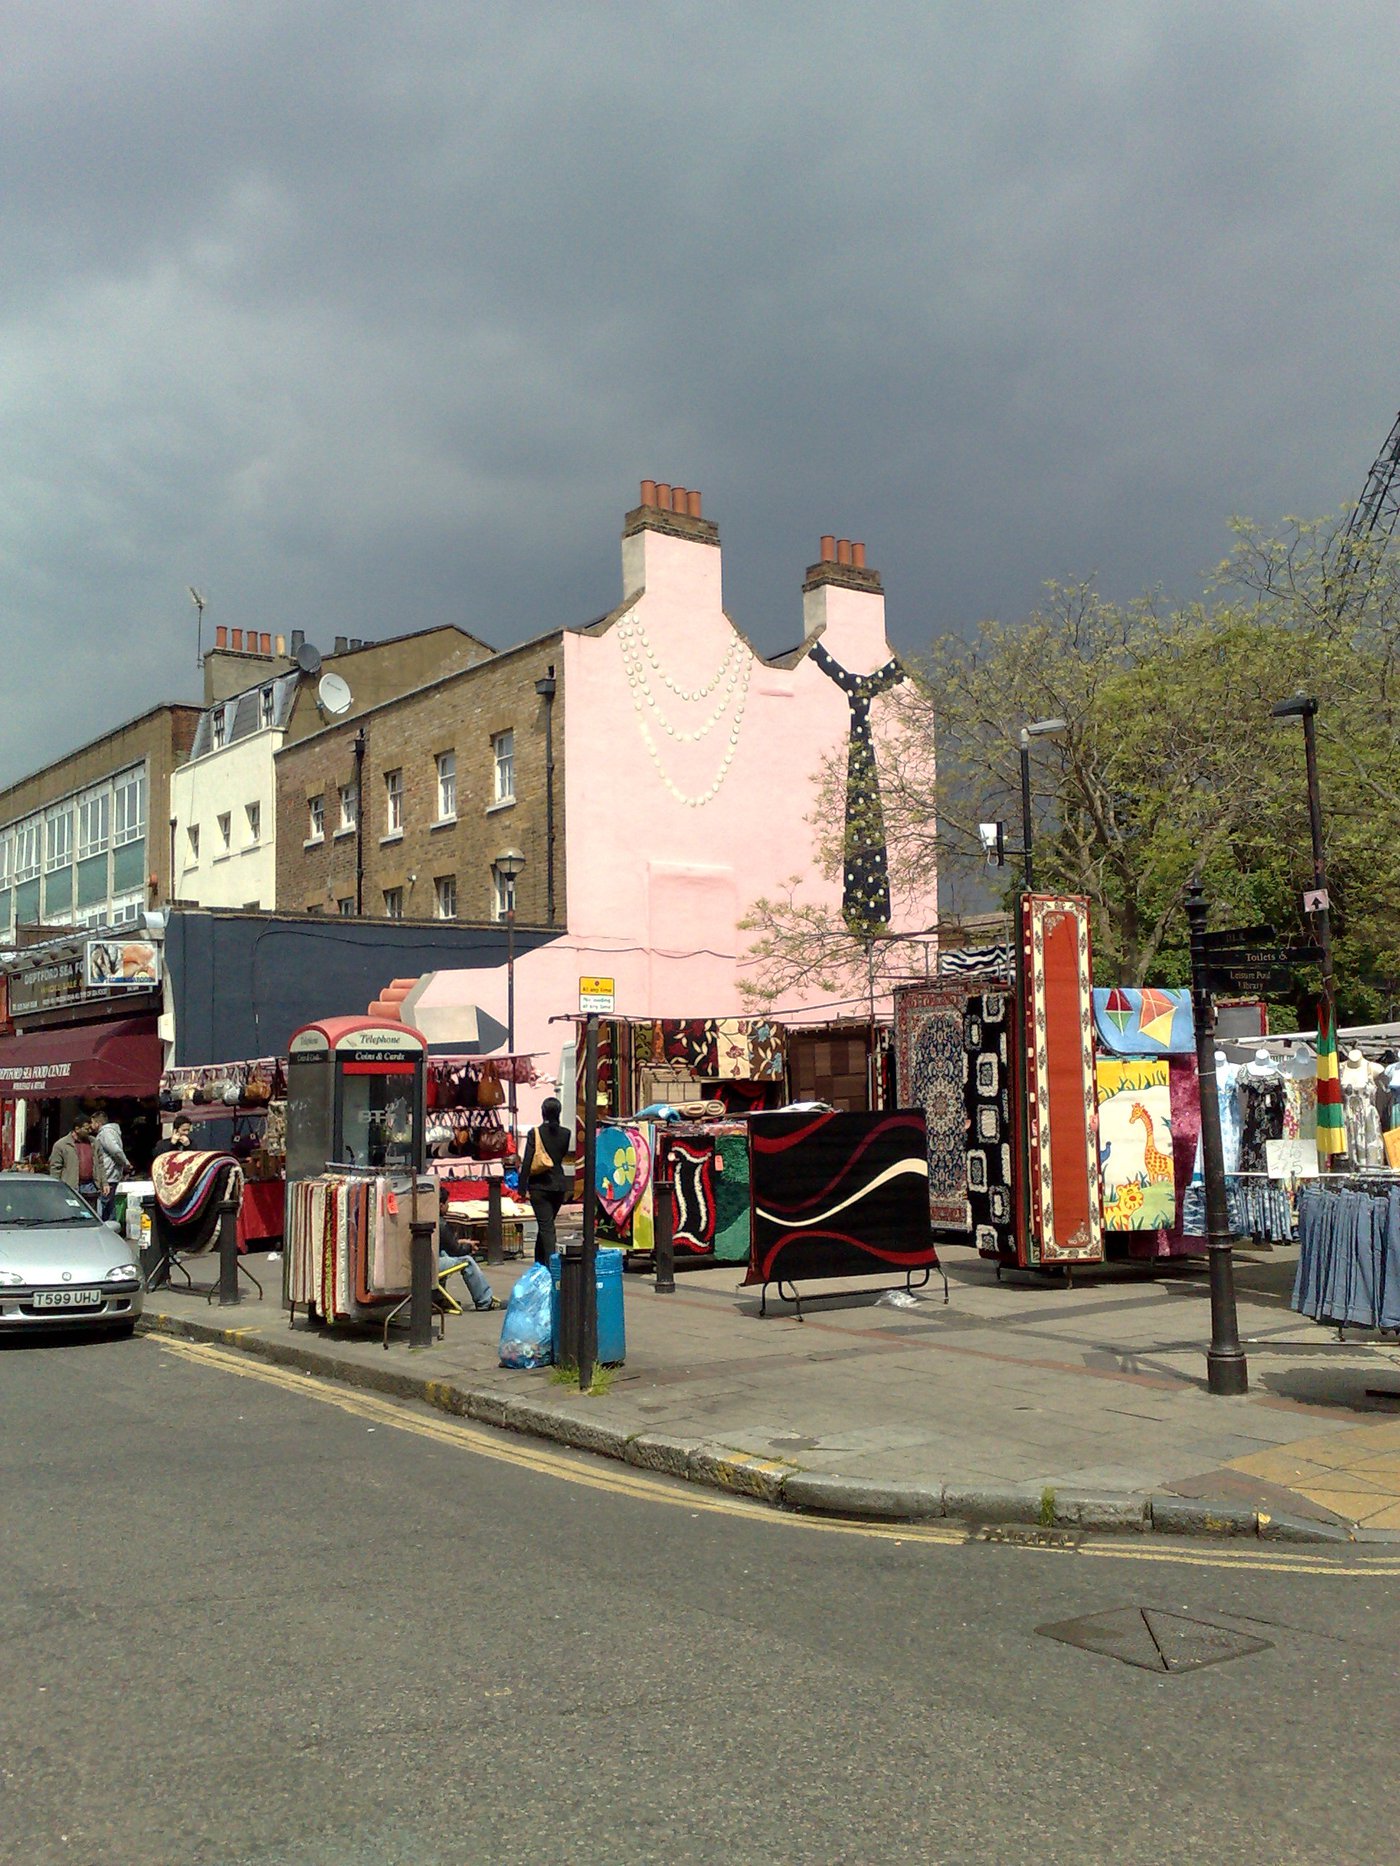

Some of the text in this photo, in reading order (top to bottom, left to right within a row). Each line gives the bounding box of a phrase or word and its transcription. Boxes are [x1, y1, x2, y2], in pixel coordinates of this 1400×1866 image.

[1245, 953, 1276, 961] Toilets
[24, 961, 84, 985] DEPTFORD SEA FO
[1230, 971, 1255, 979] Leisure
[360, 1034, 401, 1045] Telephone
[355, 1051, 405, 1061] Coins & Cards
[36, 1292, 99, 1306] T599 UHJ
